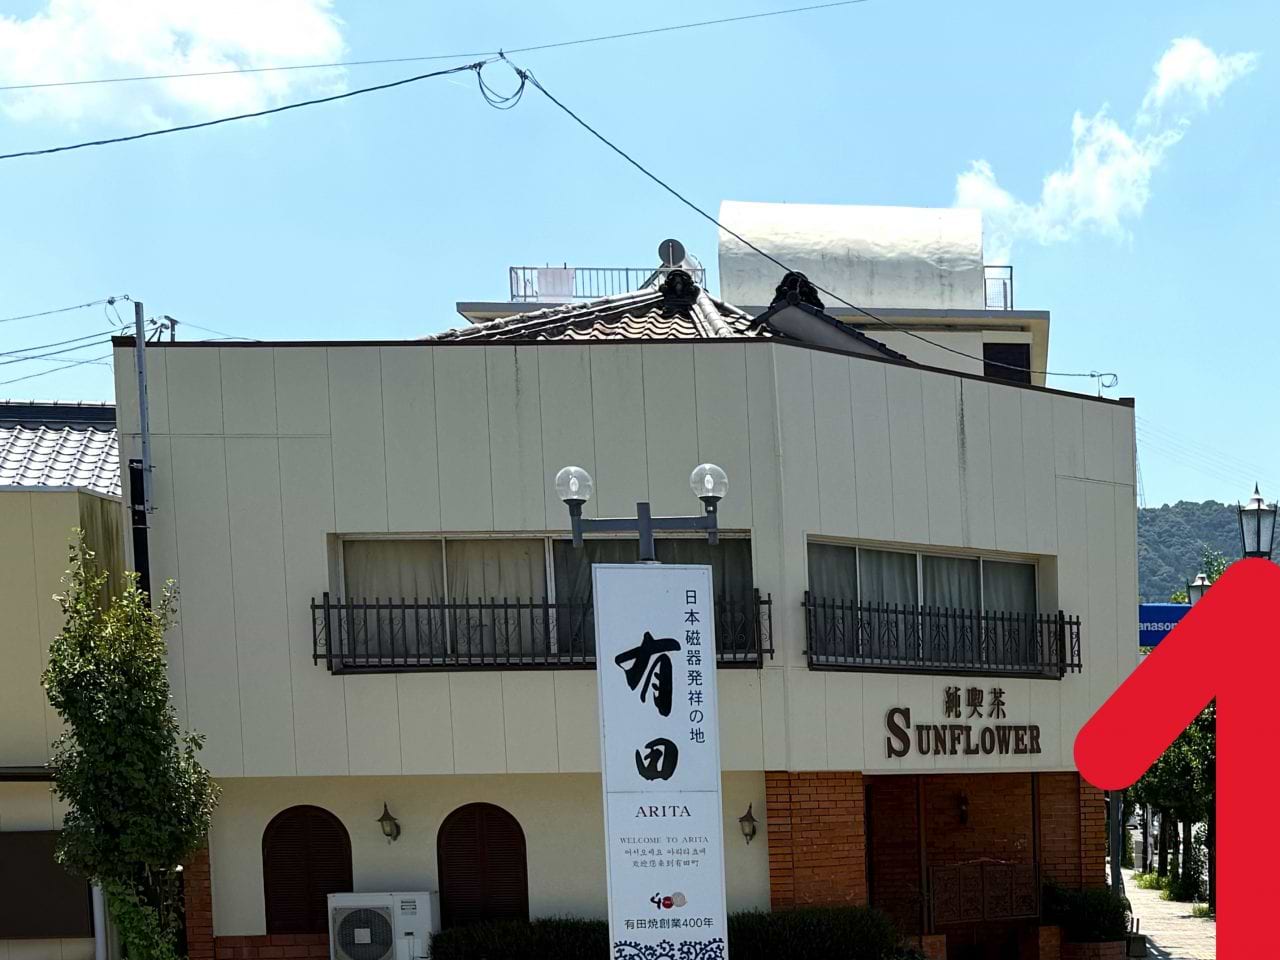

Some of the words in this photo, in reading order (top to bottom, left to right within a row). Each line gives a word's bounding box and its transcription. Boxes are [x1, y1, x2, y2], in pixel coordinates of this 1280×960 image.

[684, 590, 706, 744] 日本磁器発祥の地
[615, 631, 682, 781] 有田
[944, 686, 1006, 719] 純喫茶
[886, 707, 1042, 758] SUNFLOWER
[635, 806, 691, 817] ARITA
[624, 917, 713, 930] 有田焼創業400年
